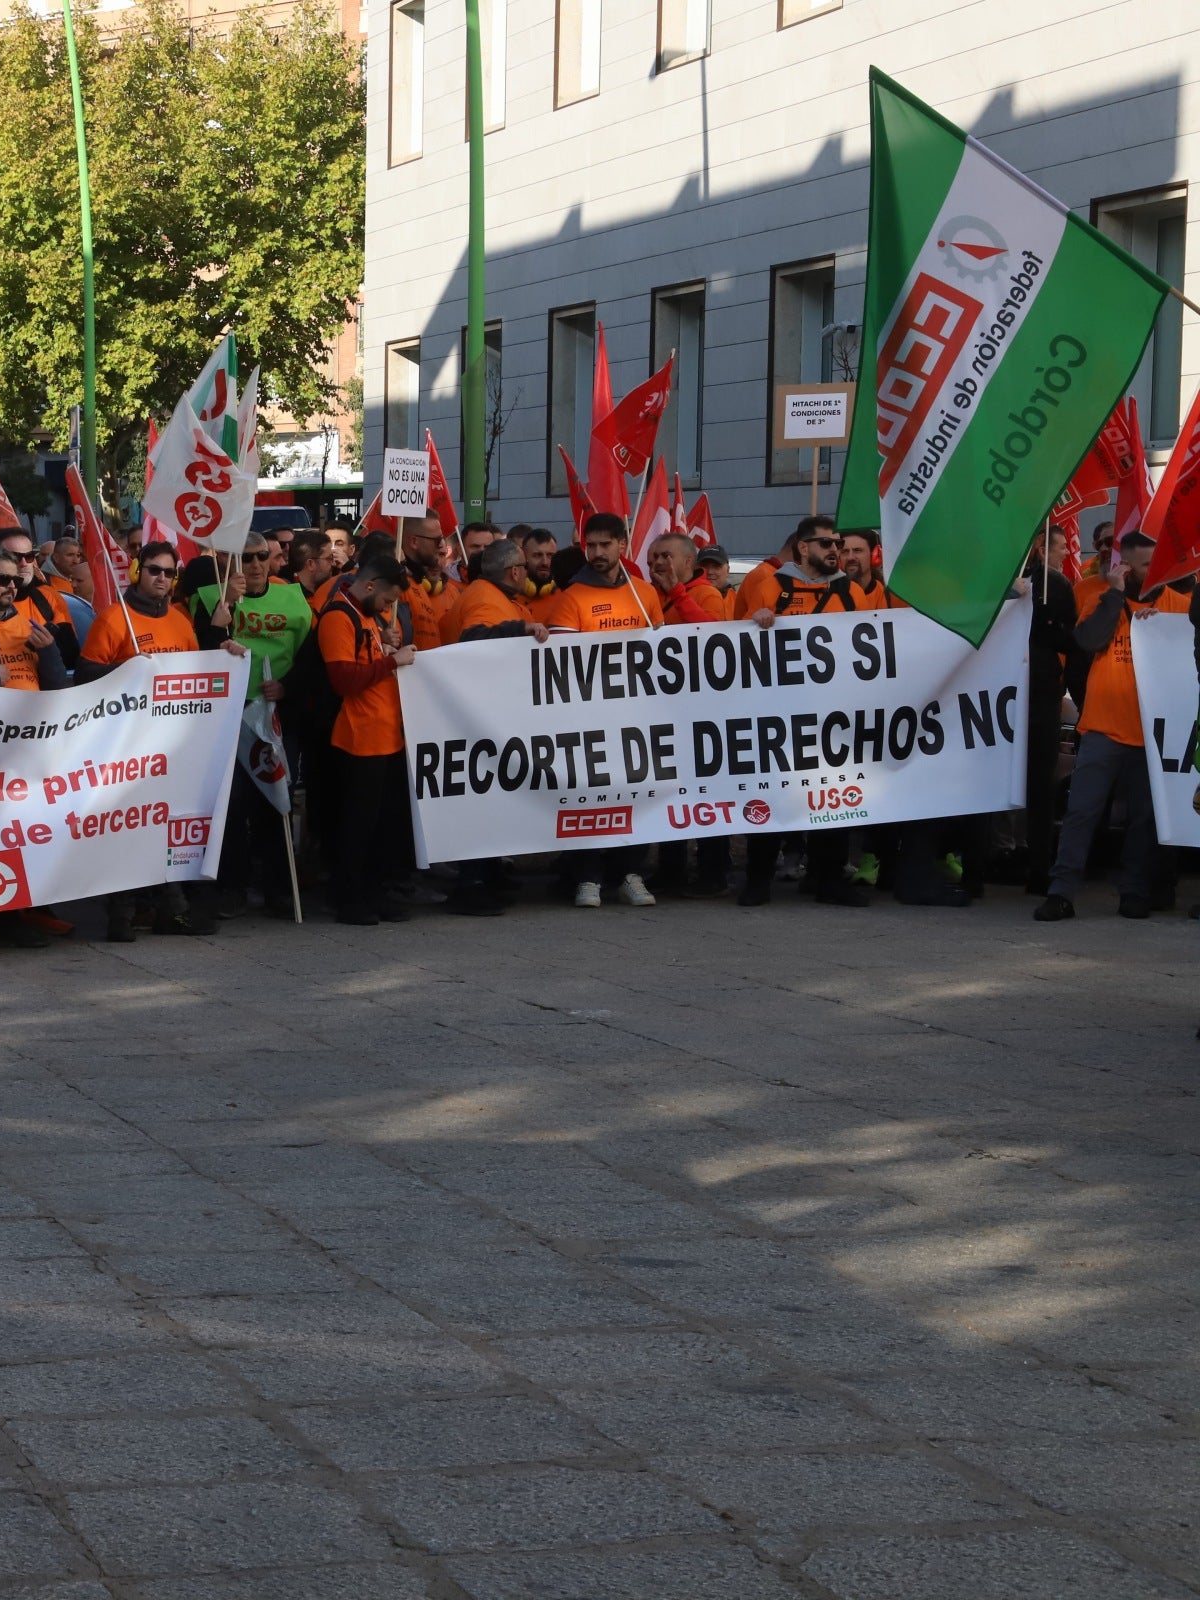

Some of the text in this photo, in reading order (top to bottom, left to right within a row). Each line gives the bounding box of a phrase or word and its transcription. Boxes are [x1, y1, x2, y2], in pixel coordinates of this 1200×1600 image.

[791, 409, 841, 417] CONDICIONES
[792, 400, 821, 408] HITACHI
[389, 469, 425, 483] NO ES UNA
[388, 486, 425, 505] OPCIÓN
[600, 616, 640, 629] Hitachi
[531, 622, 897, 706] INVERSIONES SI
[155, 677, 209, 696] CCOO
[64, 693, 147, 732] Córdoba
[152, 700, 212, 717] industria
[416, 729, 610, 800] RECORTE
[621, 723, 677, 784] DE
[692, 700, 945, 778] DERECHOS
[43, 753, 168, 805] primera
[560, 772, 866, 805] COMITE DE EMPRESA
[807, 785, 864, 811] USO
[562, 812, 627, 831] CCOO
[667, 801, 736, 829] UGT
[809, 808, 869, 825] industria
[0, 819, 52, 849] de
[65, 801, 170, 840] tercera
